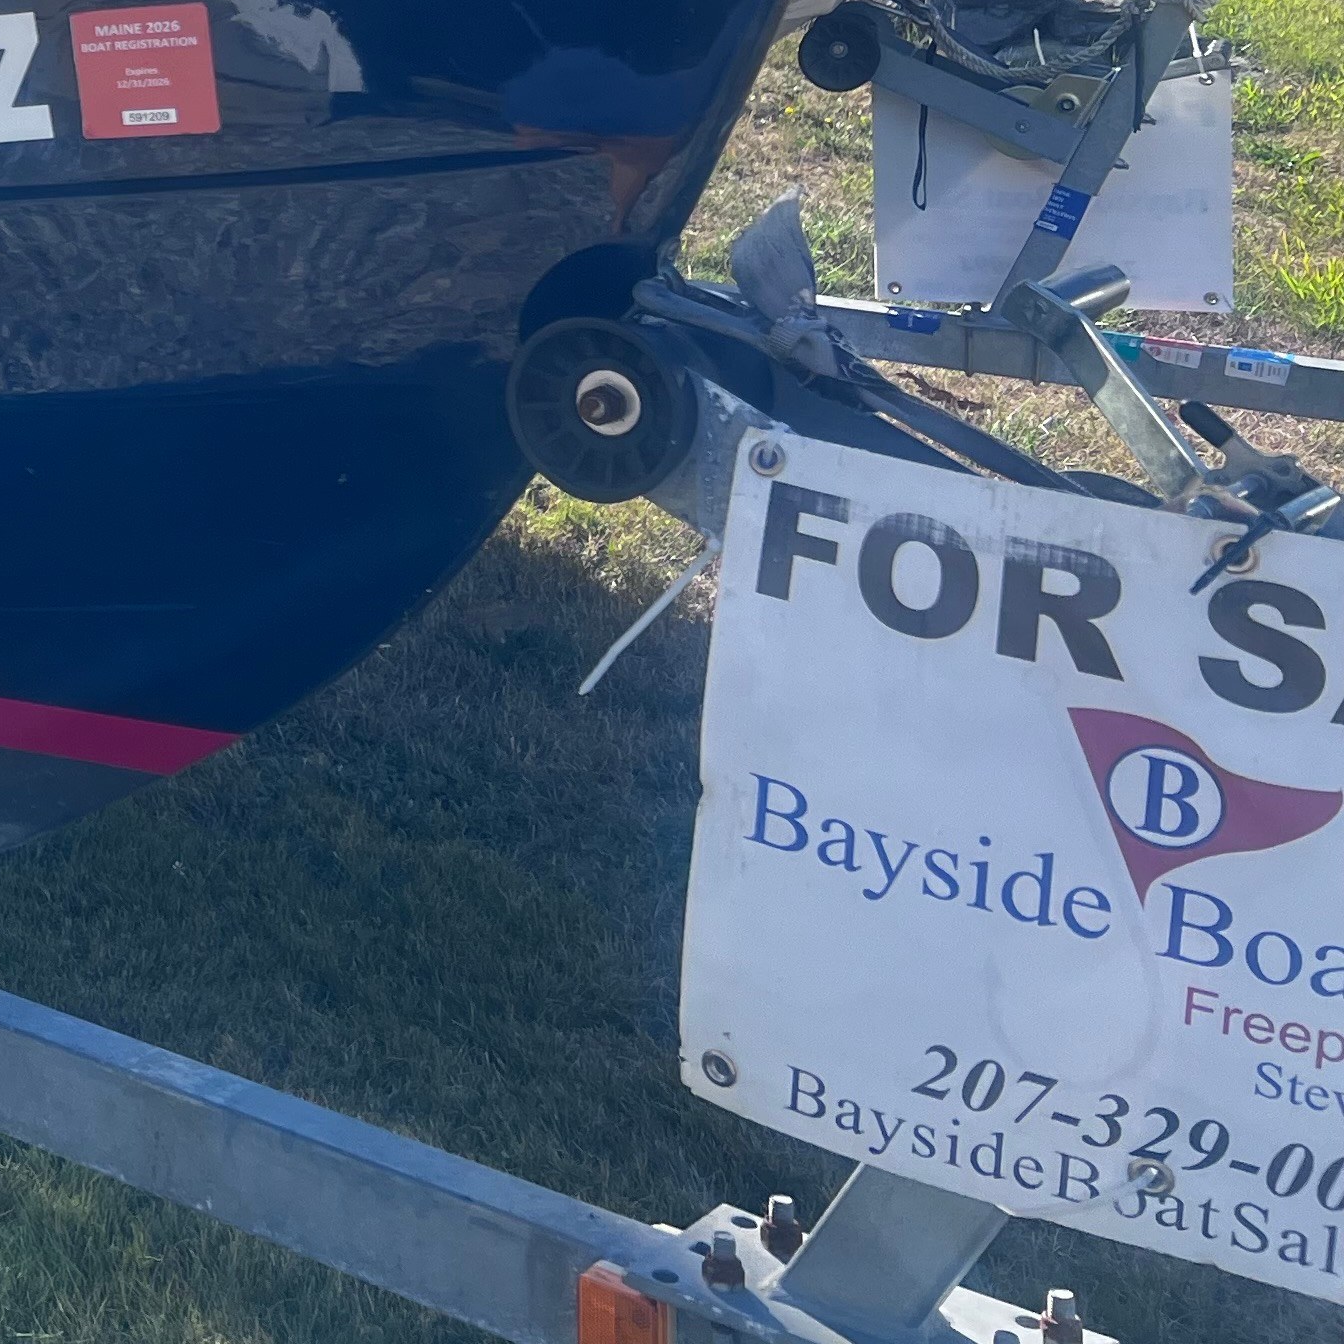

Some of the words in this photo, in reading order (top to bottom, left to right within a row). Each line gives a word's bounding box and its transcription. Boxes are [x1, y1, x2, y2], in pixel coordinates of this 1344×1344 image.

[80, 42, 112, 53] BOAT
[114, 36, 198, 51] REGISTRATION
[94, 22, 143, 37] MAINE
[146, 20, 181, 34] 2026
[116, 77, 171, 89] 12/31/2026
[125, 67, 158, 77] Expires
[128, 111, 170, 123] 591209
[756, 480, 1125, 682] FOR
[1198, 580, 1344, 725] S
[1135, 755, 1200, 838] B
[743, 772, 1112, 939] Bayside
[1184, 985, 1344, 1070] Freep
[911, 1044, 1344, 1212] 207-329-00
